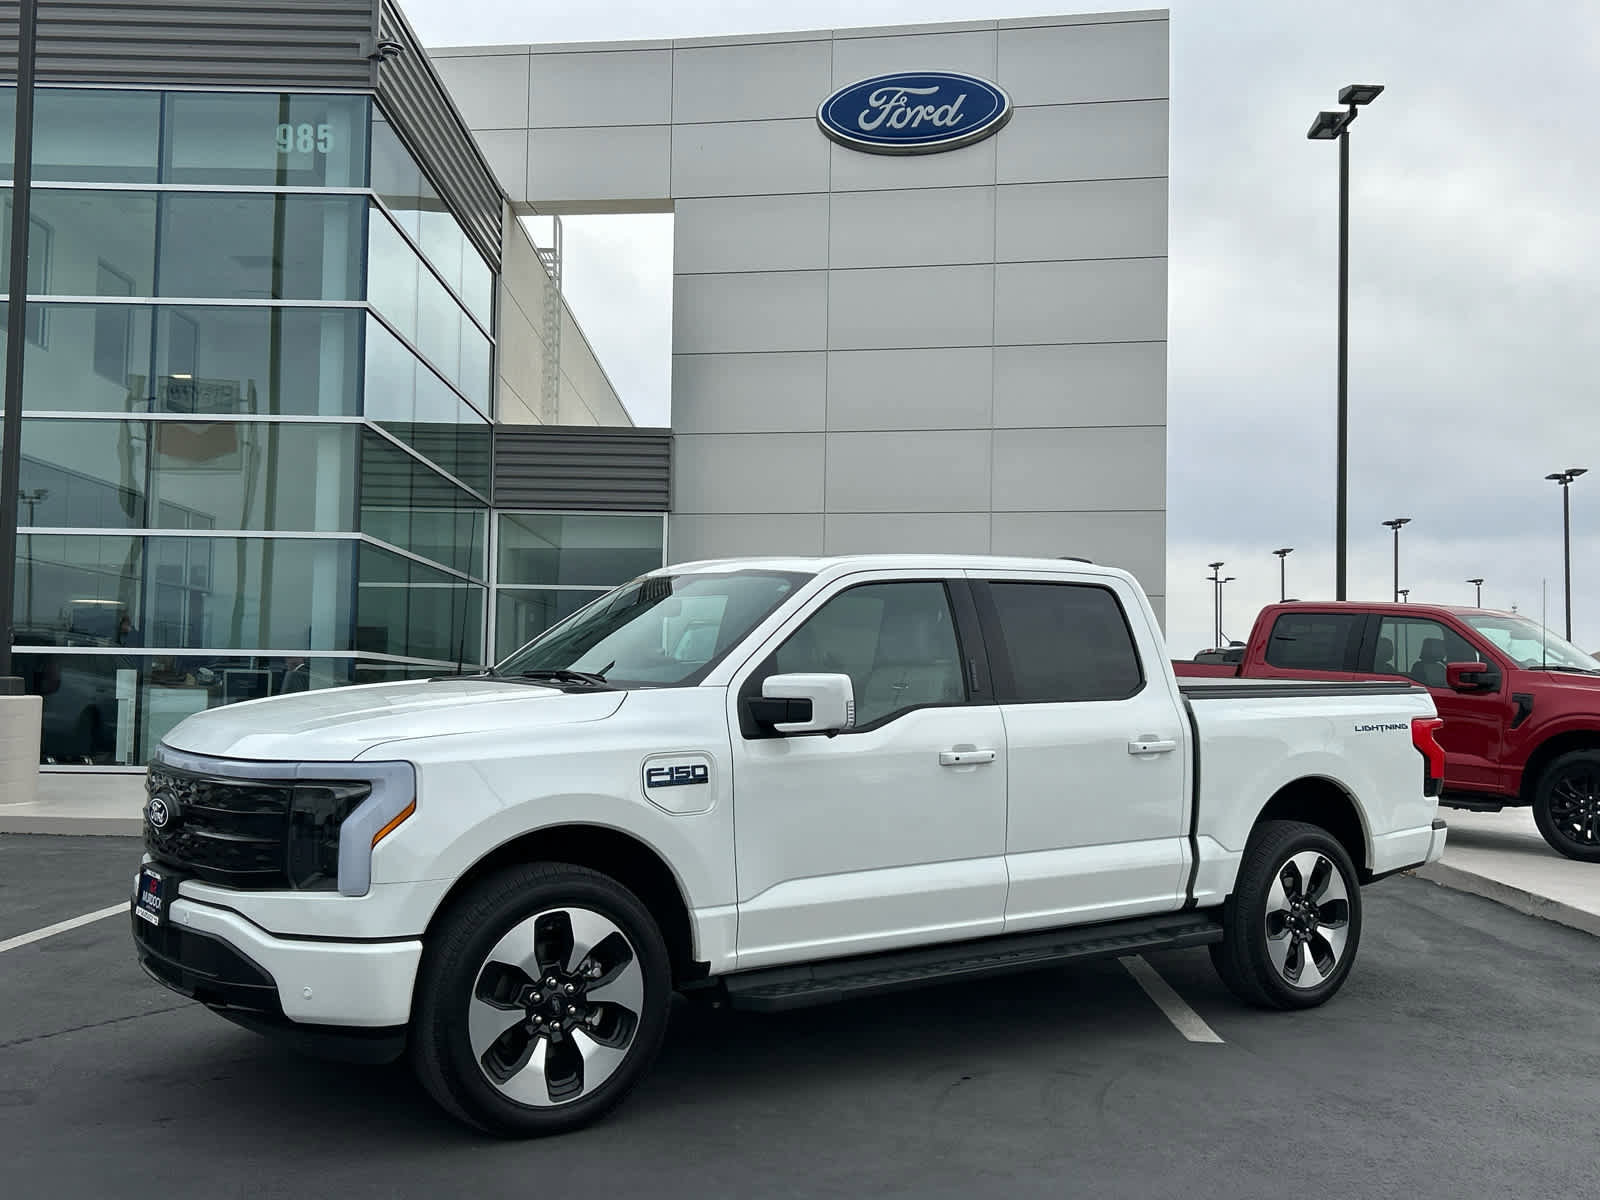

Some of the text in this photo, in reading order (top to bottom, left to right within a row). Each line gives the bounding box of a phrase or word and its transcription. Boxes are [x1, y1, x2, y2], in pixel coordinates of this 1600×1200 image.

[858, 86, 968, 131] Ford
[275, 123, 335, 153] 985
[1354, 723, 1409, 733] LIGHTNING
